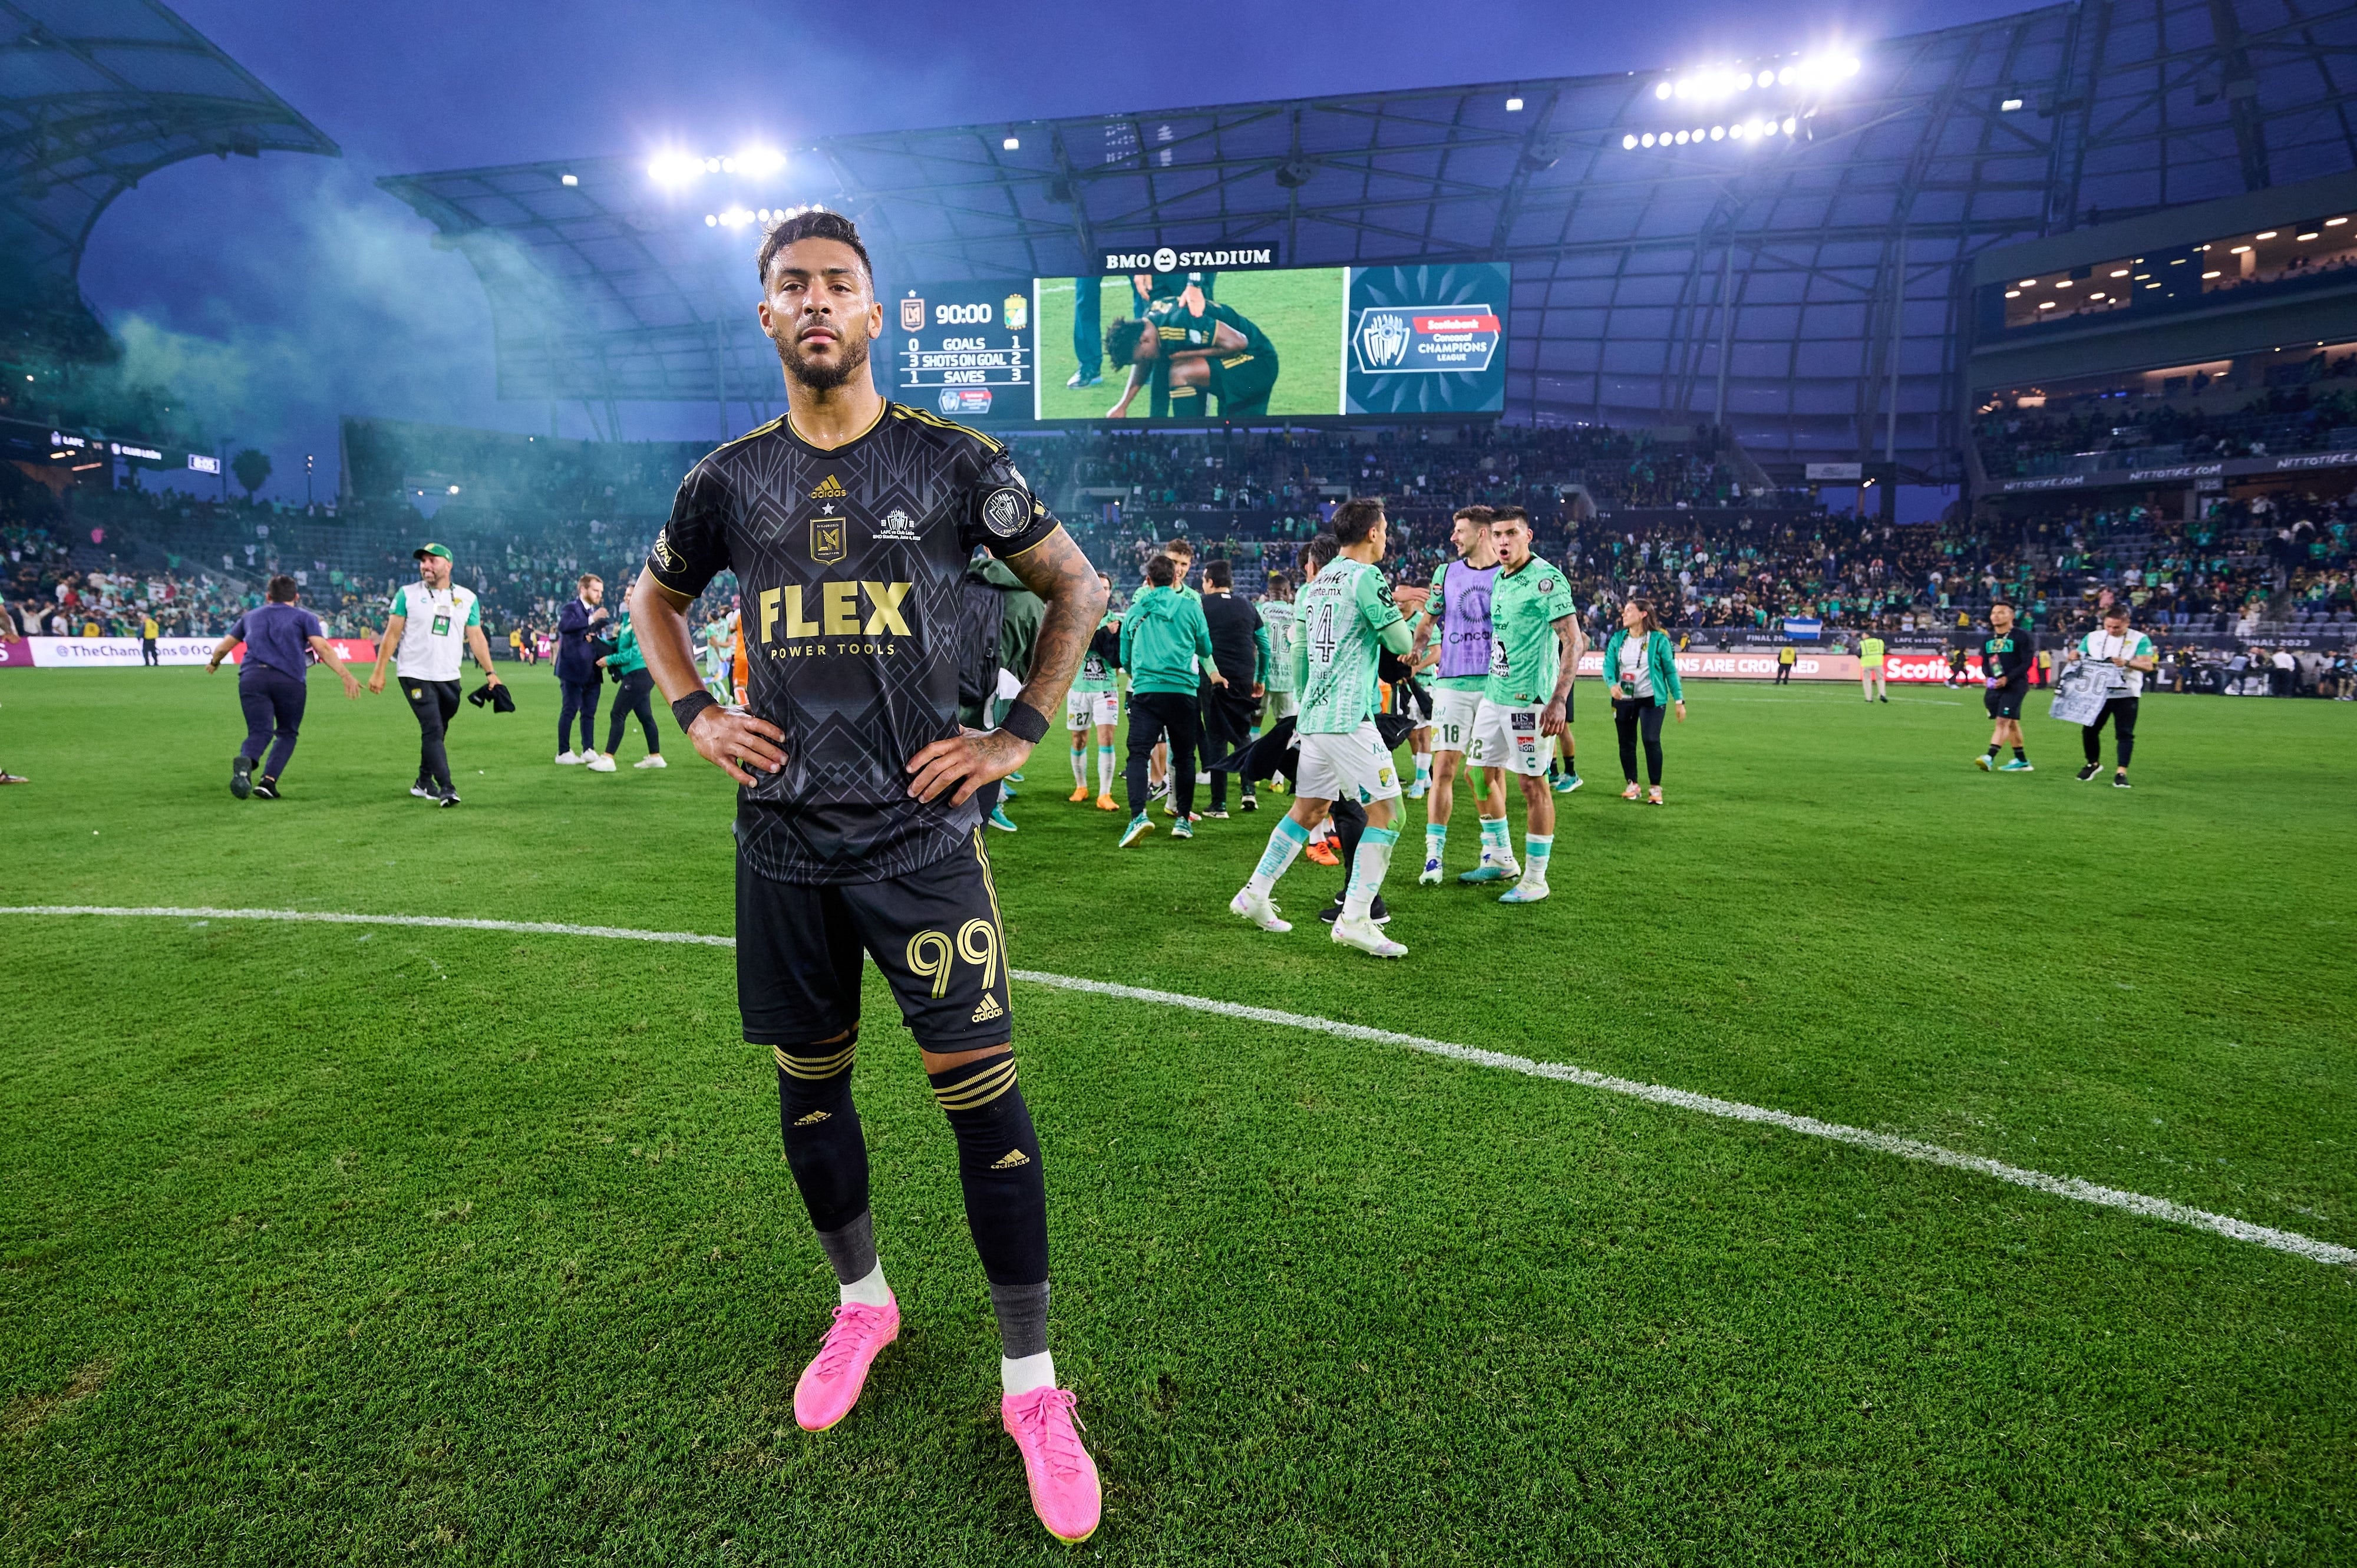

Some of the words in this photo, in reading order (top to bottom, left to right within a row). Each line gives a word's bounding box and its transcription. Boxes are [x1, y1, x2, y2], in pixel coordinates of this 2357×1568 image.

[1105, 253, 1151, 269] BMO
[1178, 249, 1272, 267] STADIUM
[935, 303, 992, 324] 90:00
[1427, 319, 1480, 330] Scotiabank
[908, 338, 919, 352] 0
[942, 336, 986, 351] GOALS
[1011, 335, 1021, 349] 1
[1432, 332, 1473, 342] Concacaf
[1417, 341, 1488, 354] CHAMPIONS
[909, 354, 919, 368] 3
[922, 354, 959, 368] SHOTS
[959, 353, 976, 367] ON
[976, 352, 1007, 367] GOAL
[1011, 351, 1021, 365] 2
[1436, 353, 1467, 362] LEAGUE
[910, 369, 919, 384] 1
[943, 369, 986, 384] SAVES
[1011, 368, 1022, 382] 3
[810, 488, 847, 499] adidas
[1003, 526, 1018, 534] FINAL
[760, 580, 913, 644] FLEX
[771, 645, 826, 660] POWER
[837, 643, 895, 655] TOOLS
[1702, 659, 1735, 672] ARE
[1076, 712, 1090, 726] 27
[1516, 714, 1529, 722] HS
[1442, 724, 1460, 744] 18
[906, 917, 998, 999] 99
[972, 1007, 1003, 1023] adidas
[991, 1157, 1030, 1169] adidas
